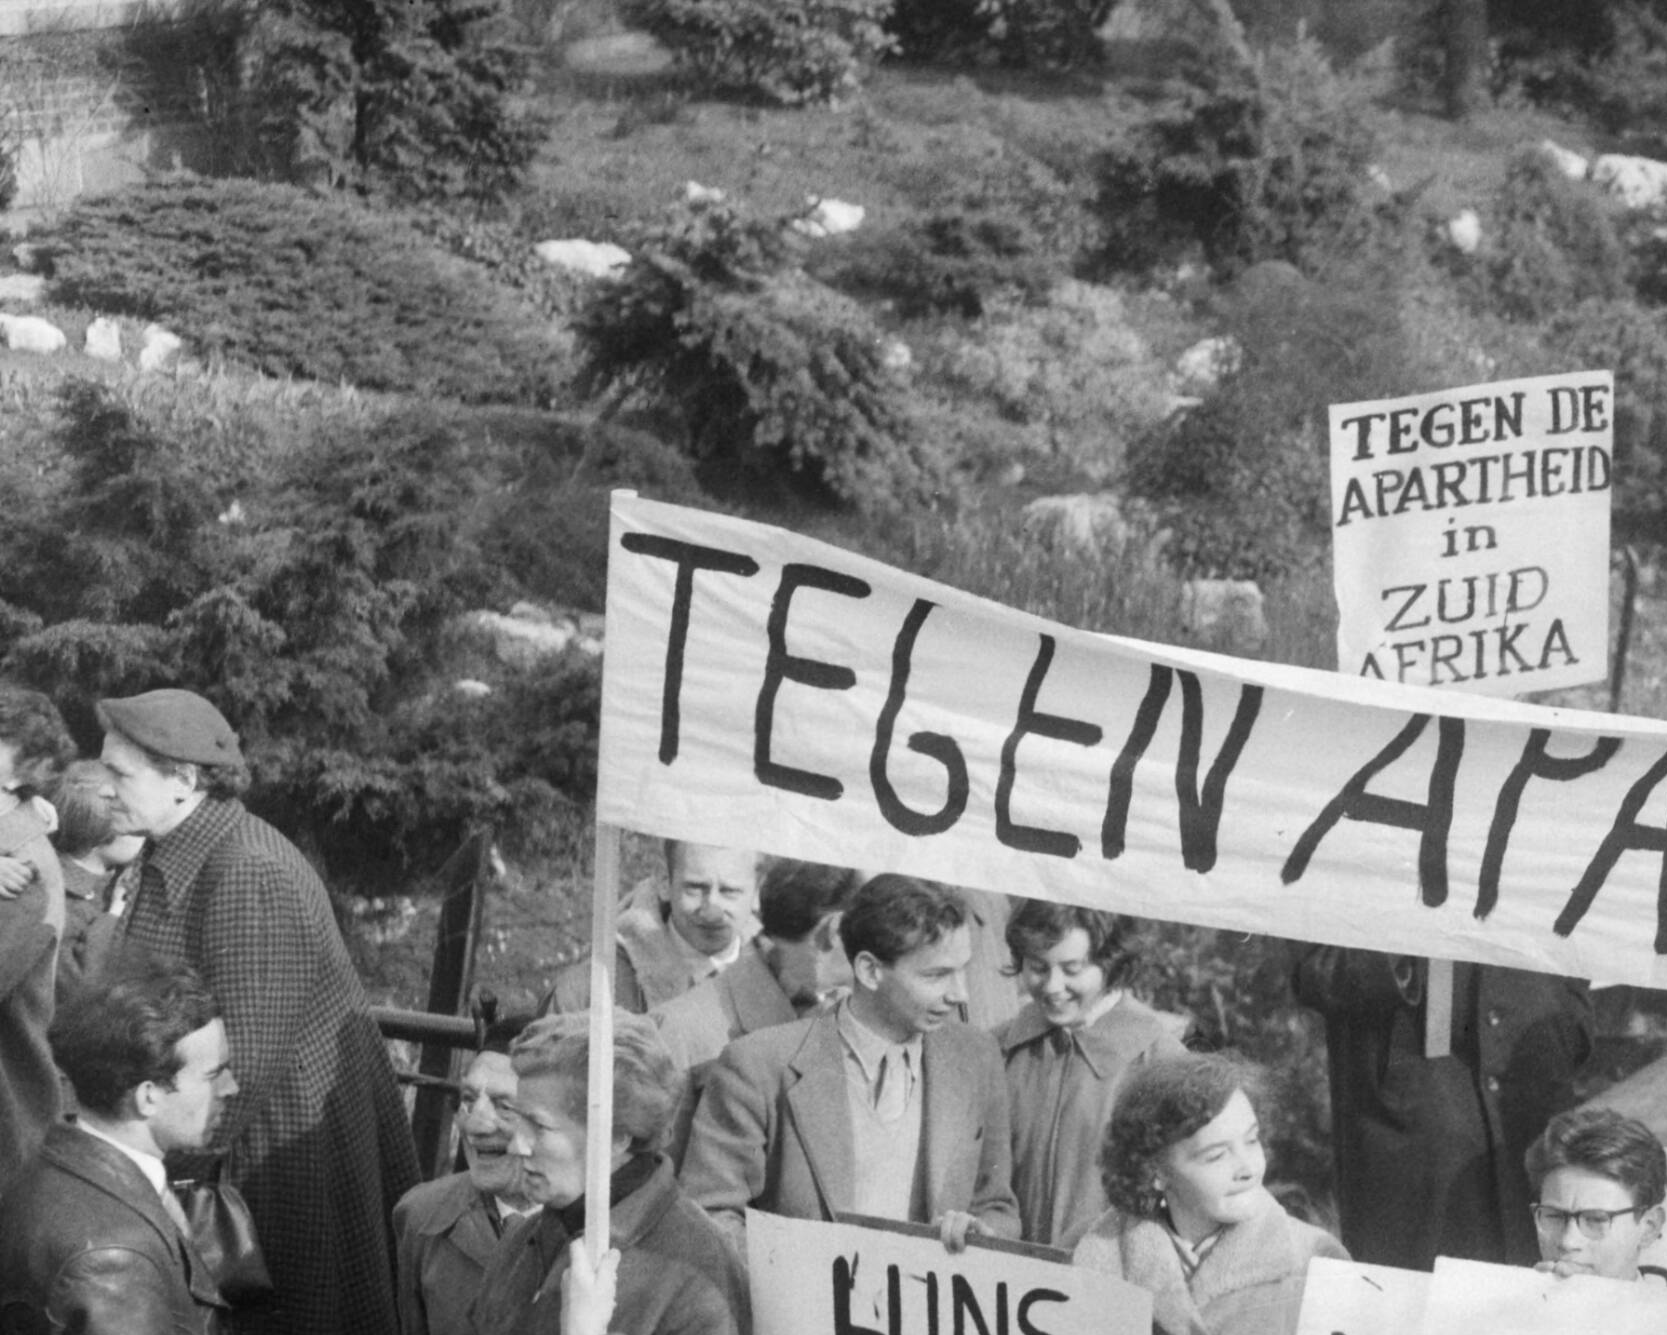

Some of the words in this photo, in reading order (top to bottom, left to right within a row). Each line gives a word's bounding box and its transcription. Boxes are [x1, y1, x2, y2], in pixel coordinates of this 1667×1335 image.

[1341, 391, 1527, 460] TEGEN
[1546, 383, 1611, 435] DE
[1336, 445, 1612, 527] APARTHEID
[1440, 518, 1499, 559] in
[1381, 565, 1550, 633] ZUID
[1359, 617, 1580, 688] AFRIKA
[621, 530, 1265, 875] TEGEN
